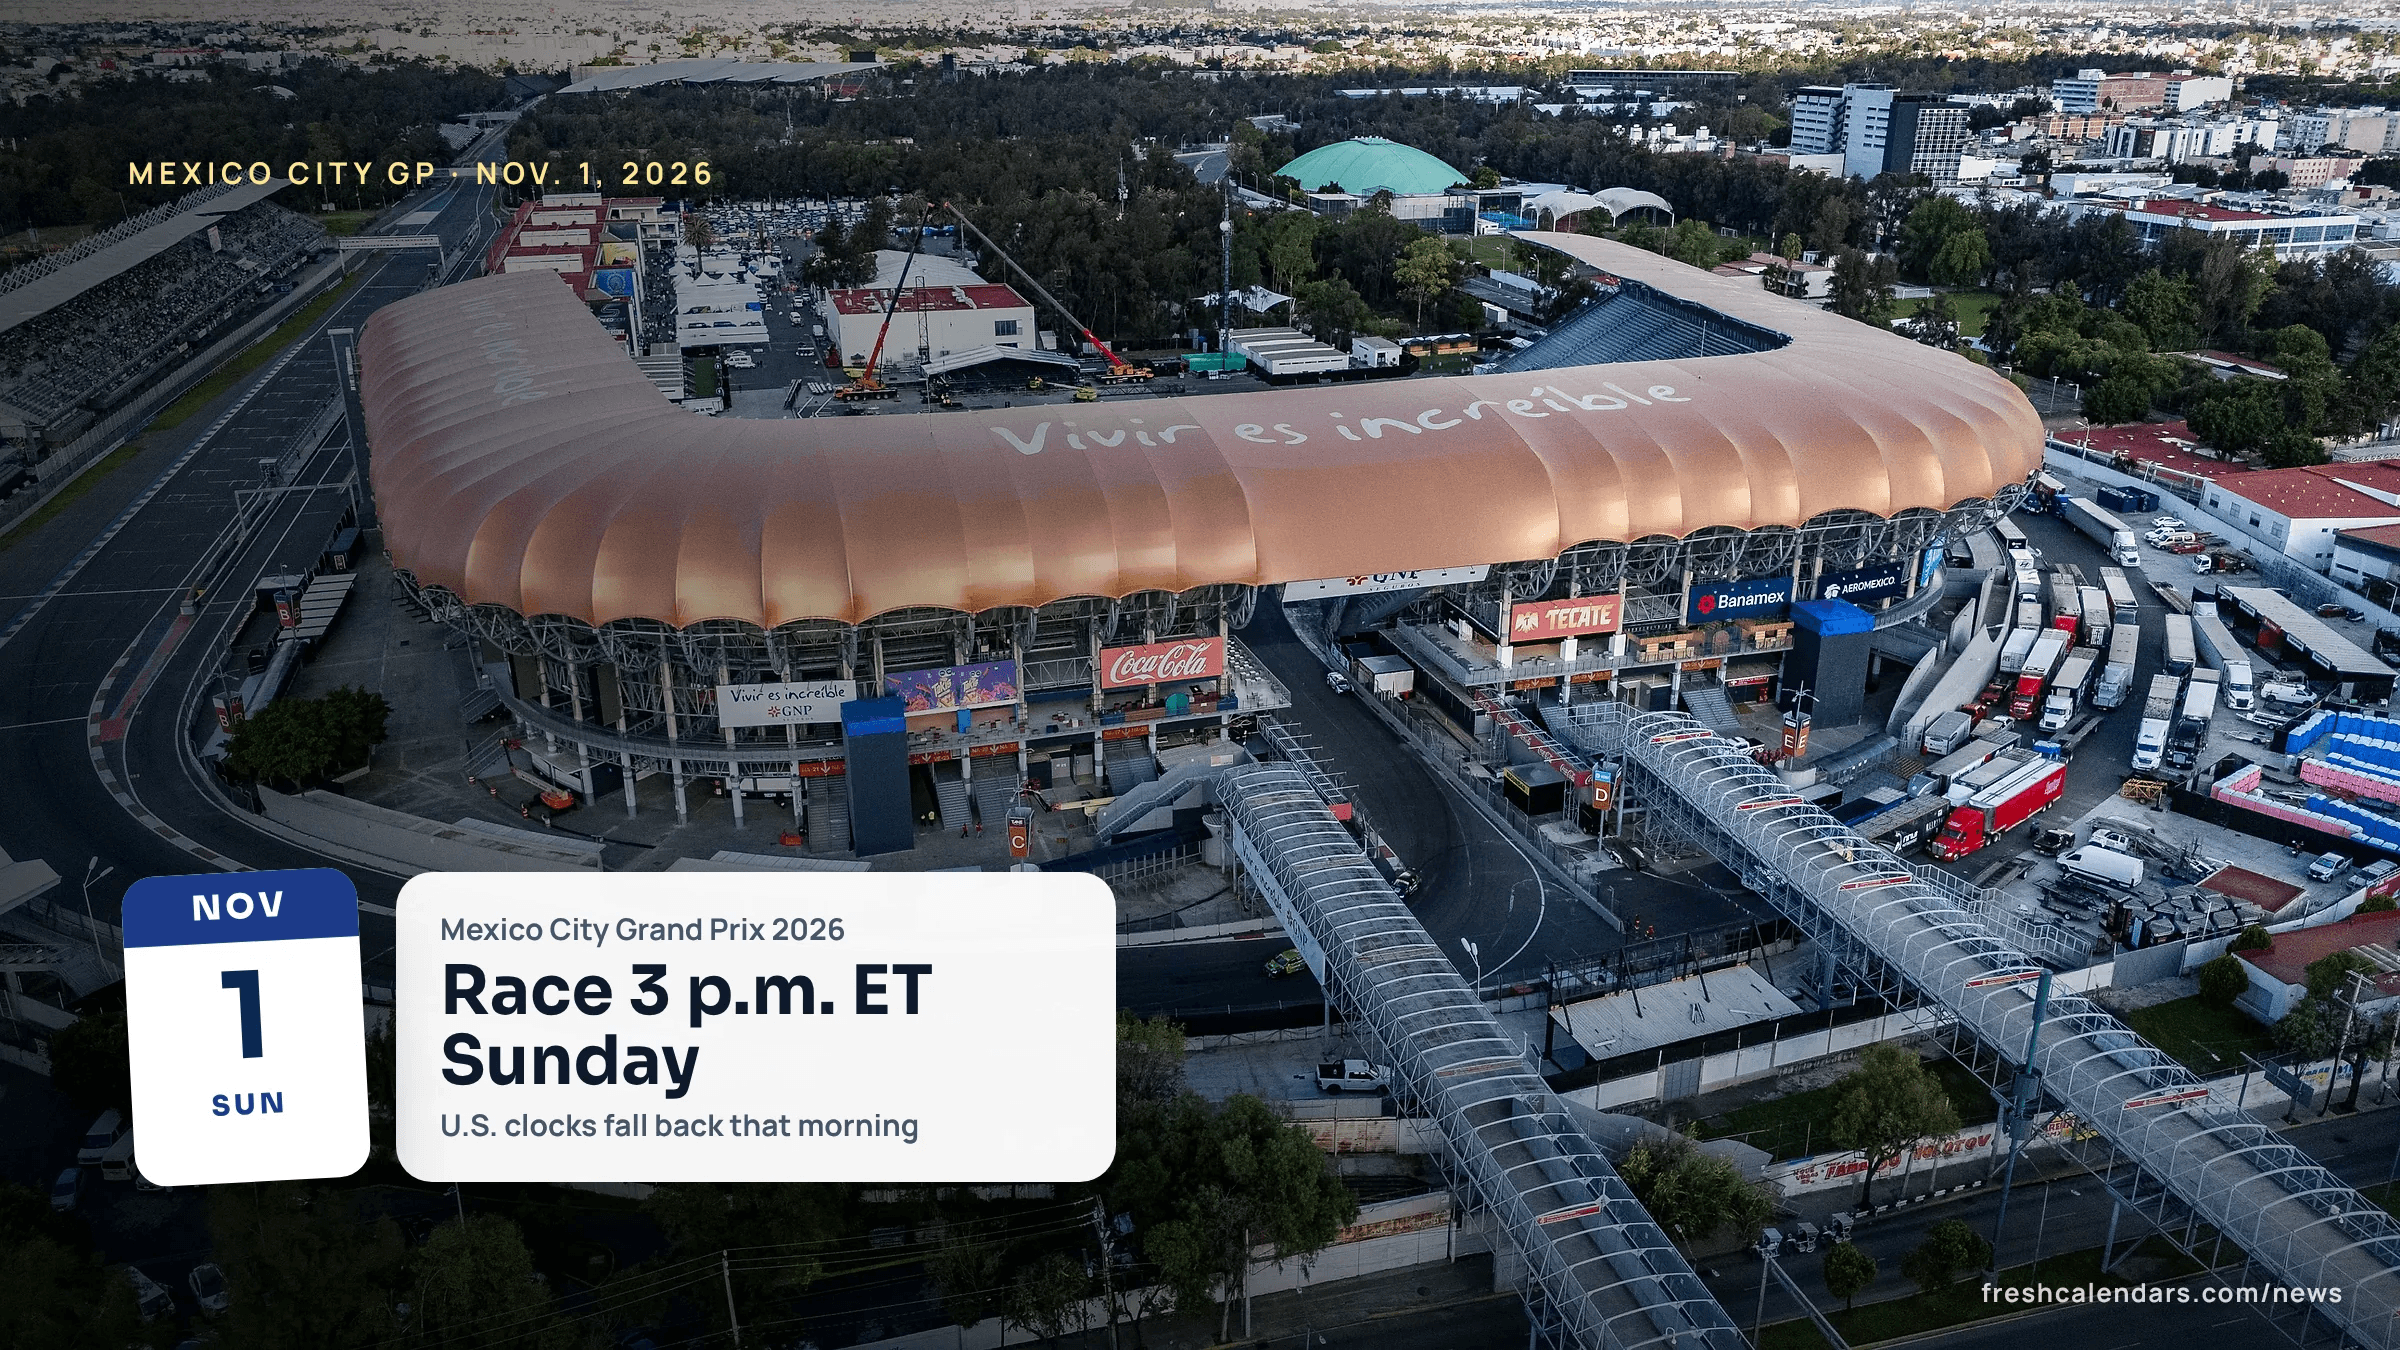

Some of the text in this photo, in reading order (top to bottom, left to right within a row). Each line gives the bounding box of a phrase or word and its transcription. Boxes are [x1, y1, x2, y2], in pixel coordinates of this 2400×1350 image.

[990, 381, 1692, 456] Vivir es increíble
[1718, 591, 1785, 610] Banamex
[279, 609, 290, 620] B
[1545, 603, 1617, 631] TECATE
[1110, 642, 1213, 684] Coca-Cola
[731, 684, 846, 702] Vivir es increíble
[782, 705, 813, 717] GNP
[219, 714, 230, 727] B
[1785, 734, 1794, 748] E
[1798, 735, 1807, 749] E
[1595, 787, 1608, 802] D
[1012, 835, 1025, 849] C
